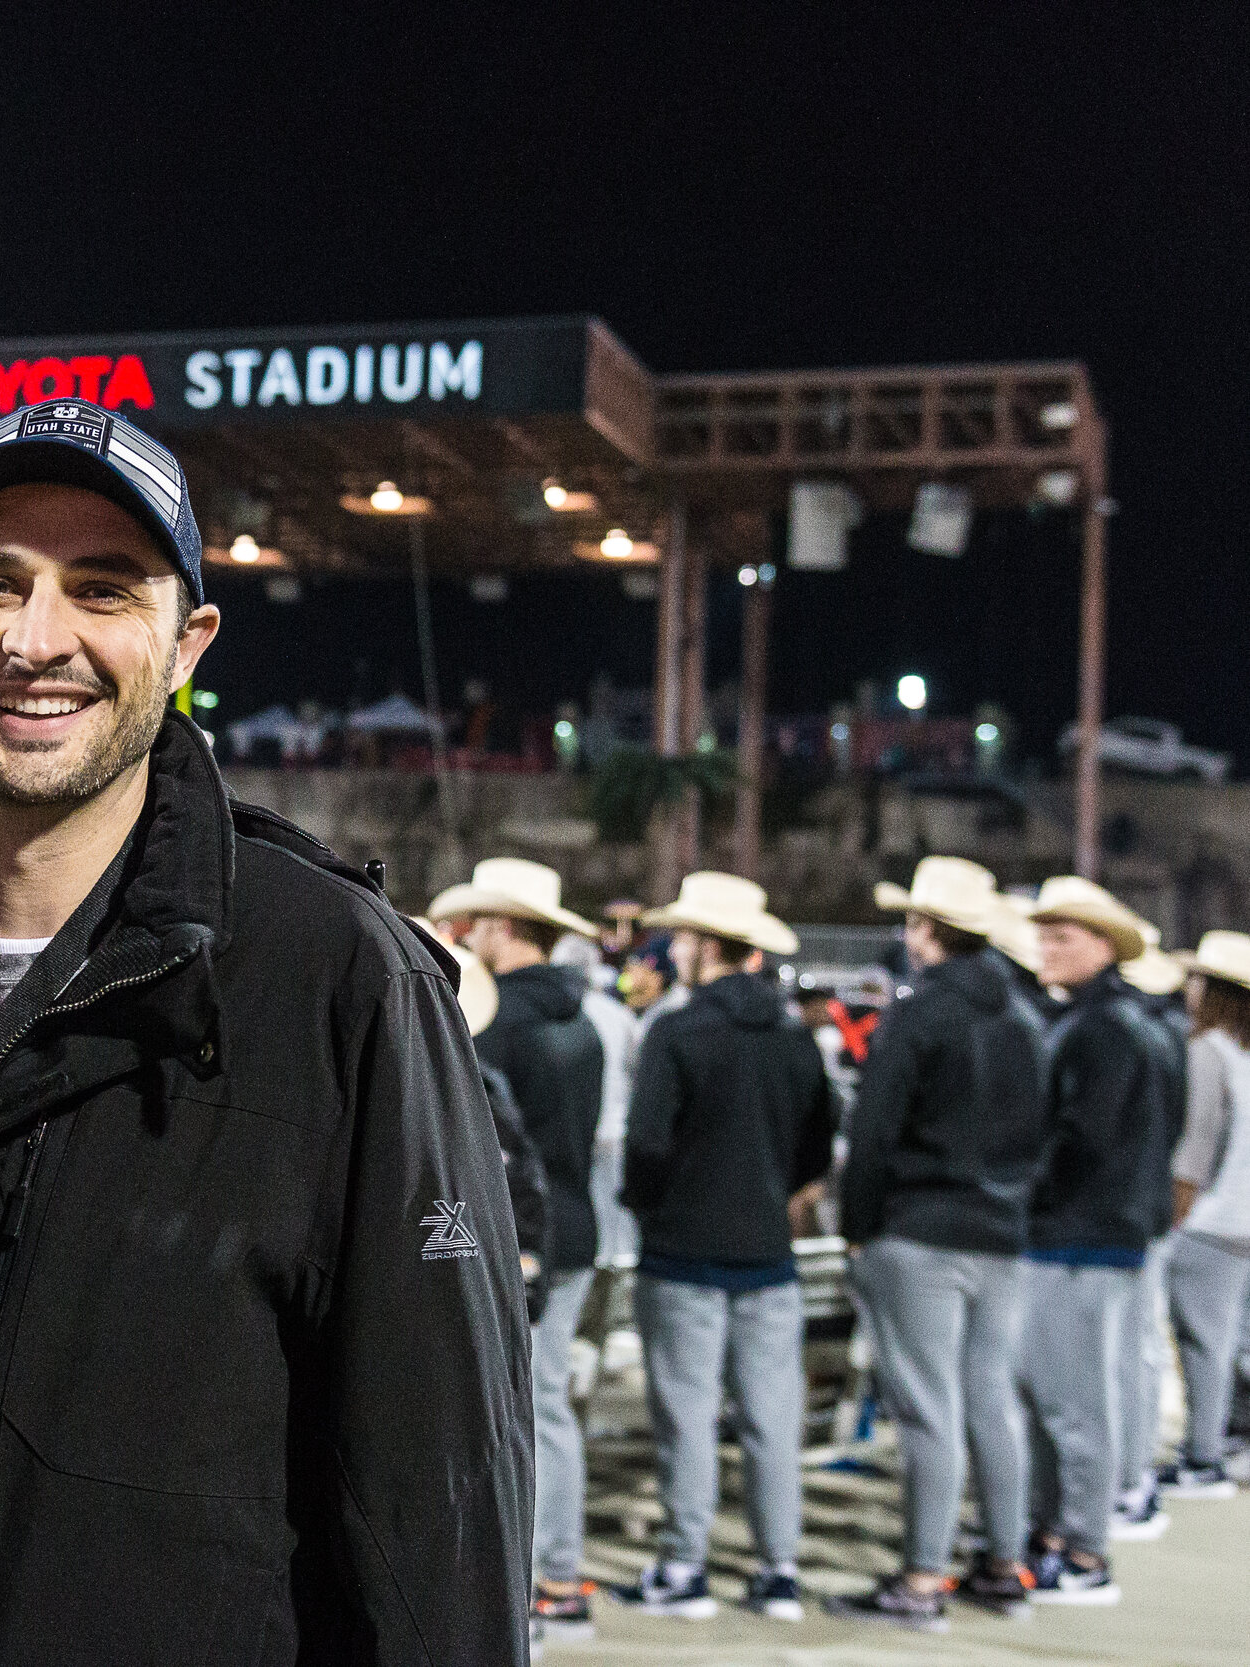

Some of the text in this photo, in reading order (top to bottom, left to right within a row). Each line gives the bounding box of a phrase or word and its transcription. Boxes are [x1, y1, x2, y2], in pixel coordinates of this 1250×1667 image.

[185, 340, 483, 410] STADIUM
[26, 422, 100, 437] UTAH STATE
